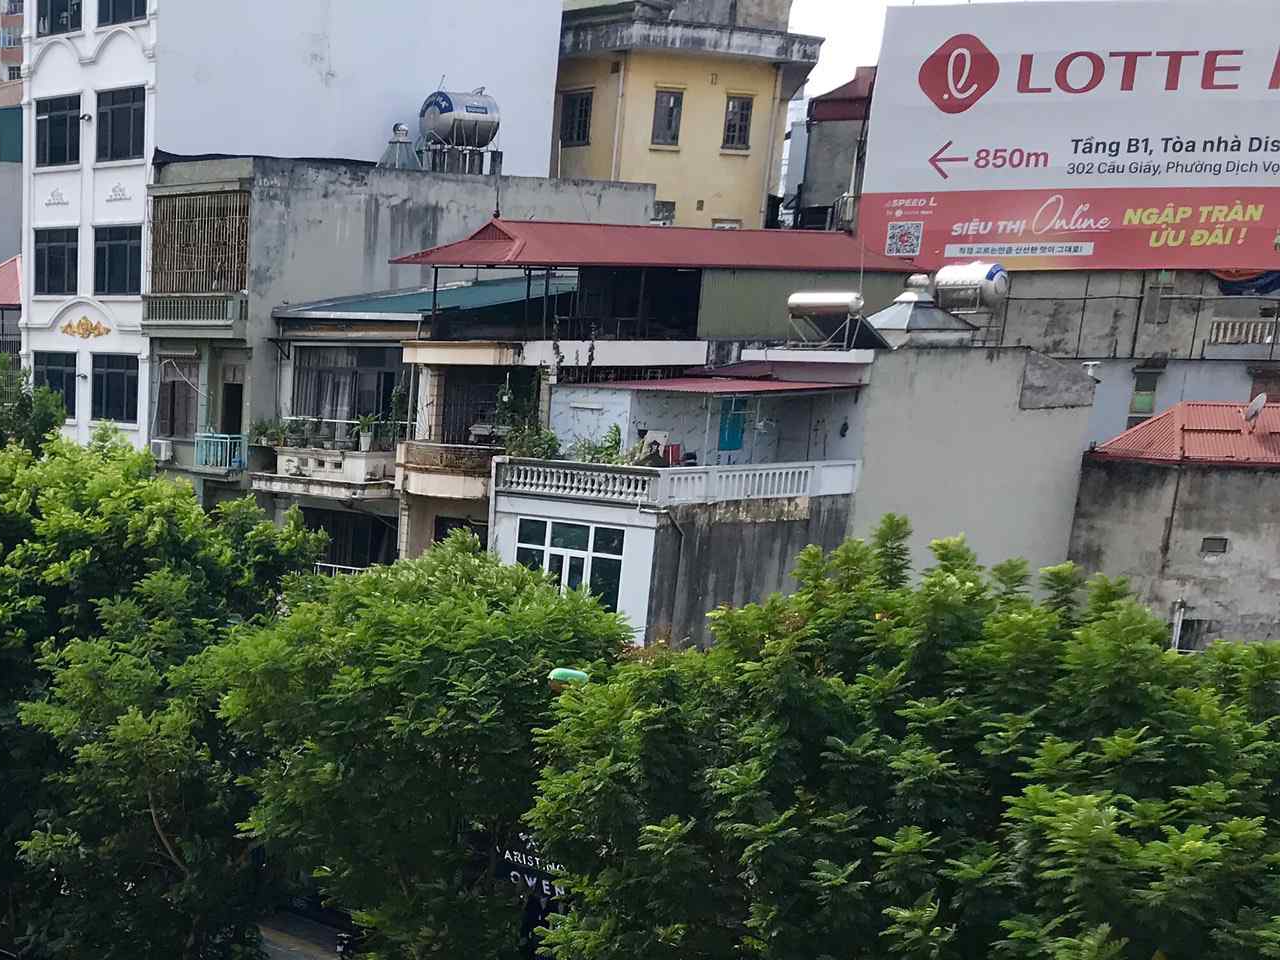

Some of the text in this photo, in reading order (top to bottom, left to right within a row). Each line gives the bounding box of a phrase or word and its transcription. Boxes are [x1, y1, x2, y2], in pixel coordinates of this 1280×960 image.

[1016, 50, 1244, 94] LOTTE
[1071, 136, 1120, 157] Tầng
[1126, 138, 1154, 155] B1,
[1161, 136, 1196, 153] Tòa
[1202, 136, 1242, 153] nhà
[974, 148, 1049, 170] 850m
[1067, 162, 1093, 175] 302
[1166, 161, 1221, 176] Phường
[1226, 160, 1258, 176] Dịch
[893, 198, 928, 208] SPEED
[1123, 200, 1264, 226] NGẬP TRÀN
[951, 194, 1112, 237] SIÊU THỊ Online
[1190, 224, 1233, 246] ĐÃI
[504, 849, 567, 873] ARISTNO
[510, 870, 565, 897] OWEN
